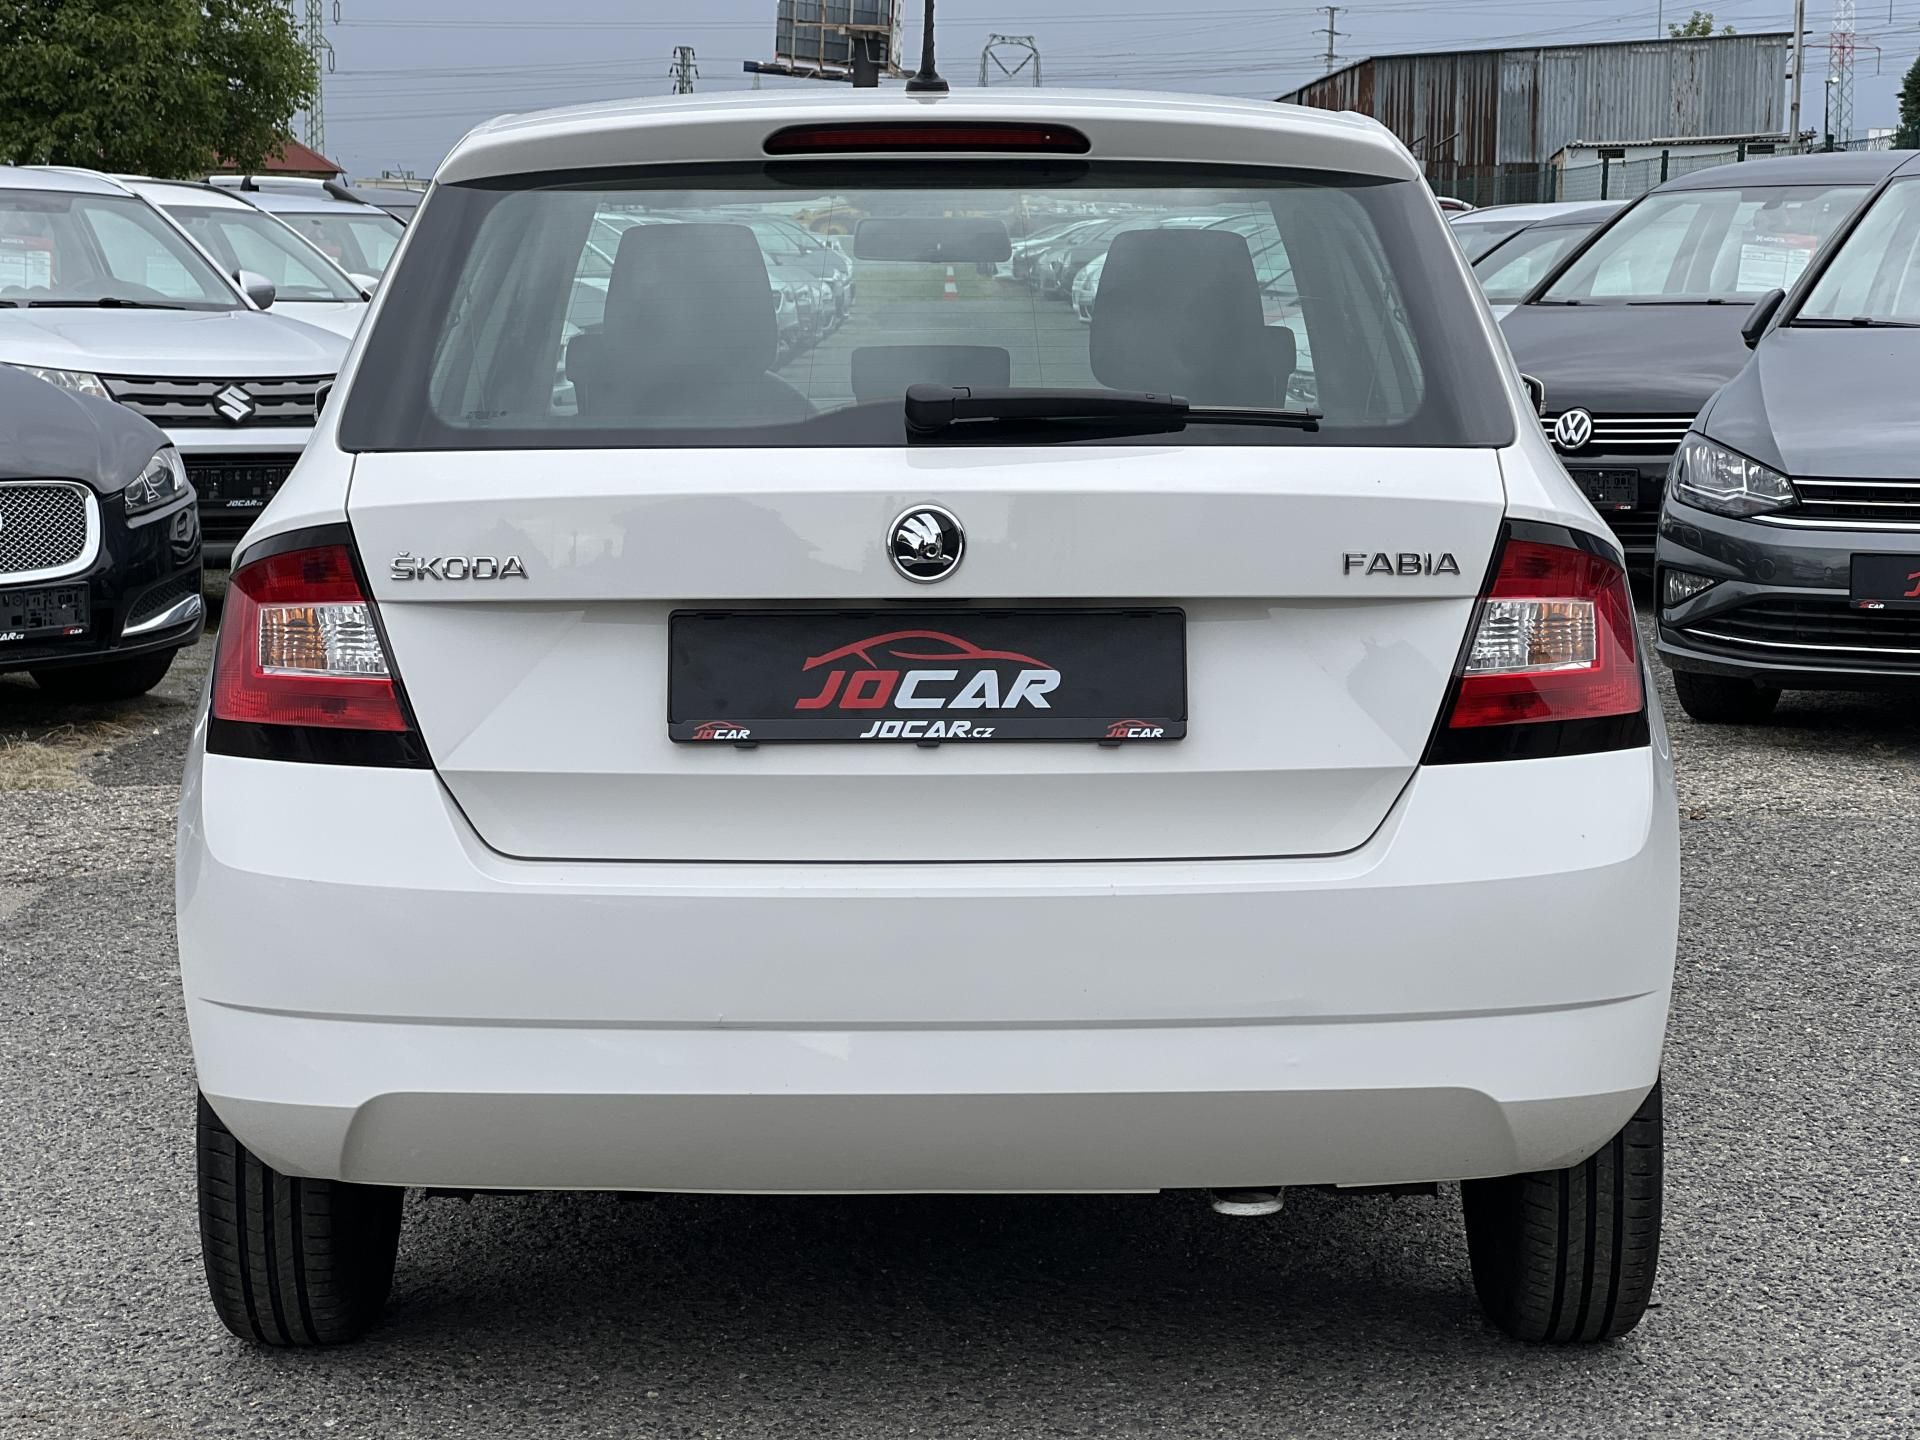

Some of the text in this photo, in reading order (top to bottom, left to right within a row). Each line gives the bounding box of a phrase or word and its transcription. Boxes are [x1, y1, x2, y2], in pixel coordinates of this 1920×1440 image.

[390, 551, 529, 581] ŠKODA
[1342, 552, 1461, 576] FABIA
[794, 669, 1061, 709] JOCAR
[692, 729, 751, 740] JOCAR
[860, 720, 996, 738] JOCAR.cz
[1105, 727, 1164, 738] JOCAR
